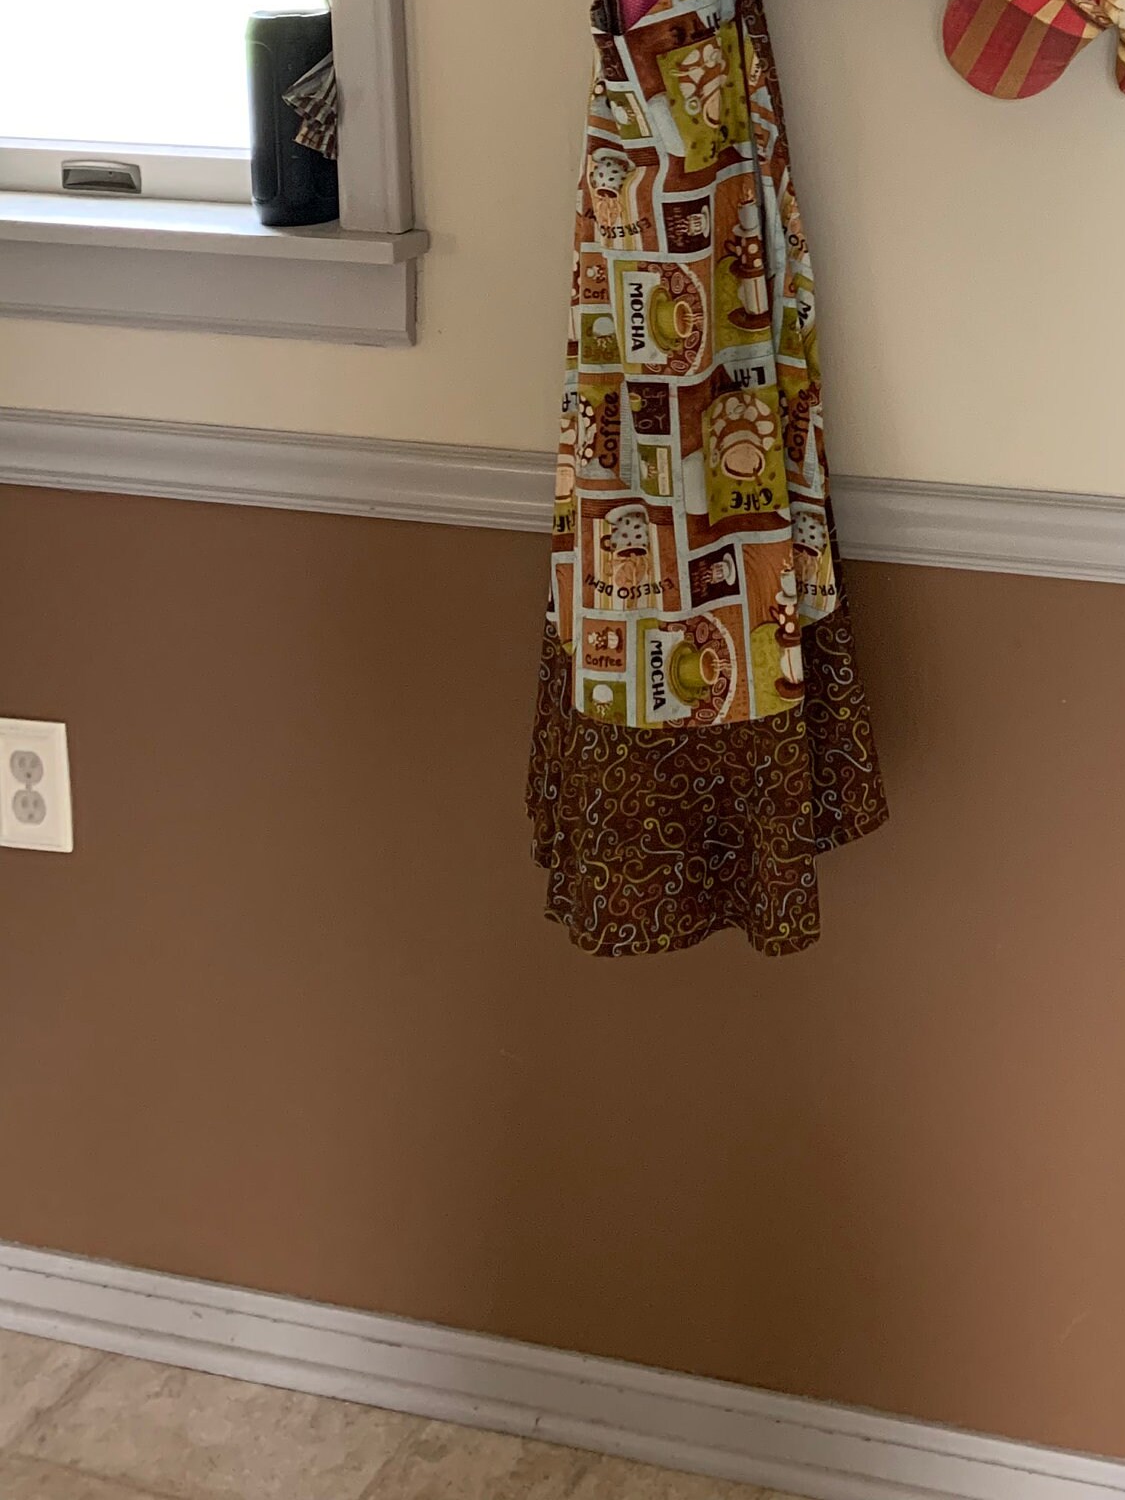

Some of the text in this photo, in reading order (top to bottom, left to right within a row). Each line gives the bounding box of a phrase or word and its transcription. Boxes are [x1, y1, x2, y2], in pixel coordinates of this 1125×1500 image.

[629, 282, 645, 351] MOCHA
[599, 391, 621, 469] Coffee
[787, 389, 811, 462] Coffee
[730, 488, 773, 511] CAFE
[585, 574, 614, 597] DEMI
[585, 654, 623, 668] Coffee
[650, 640, 666, 710] MOCHA
